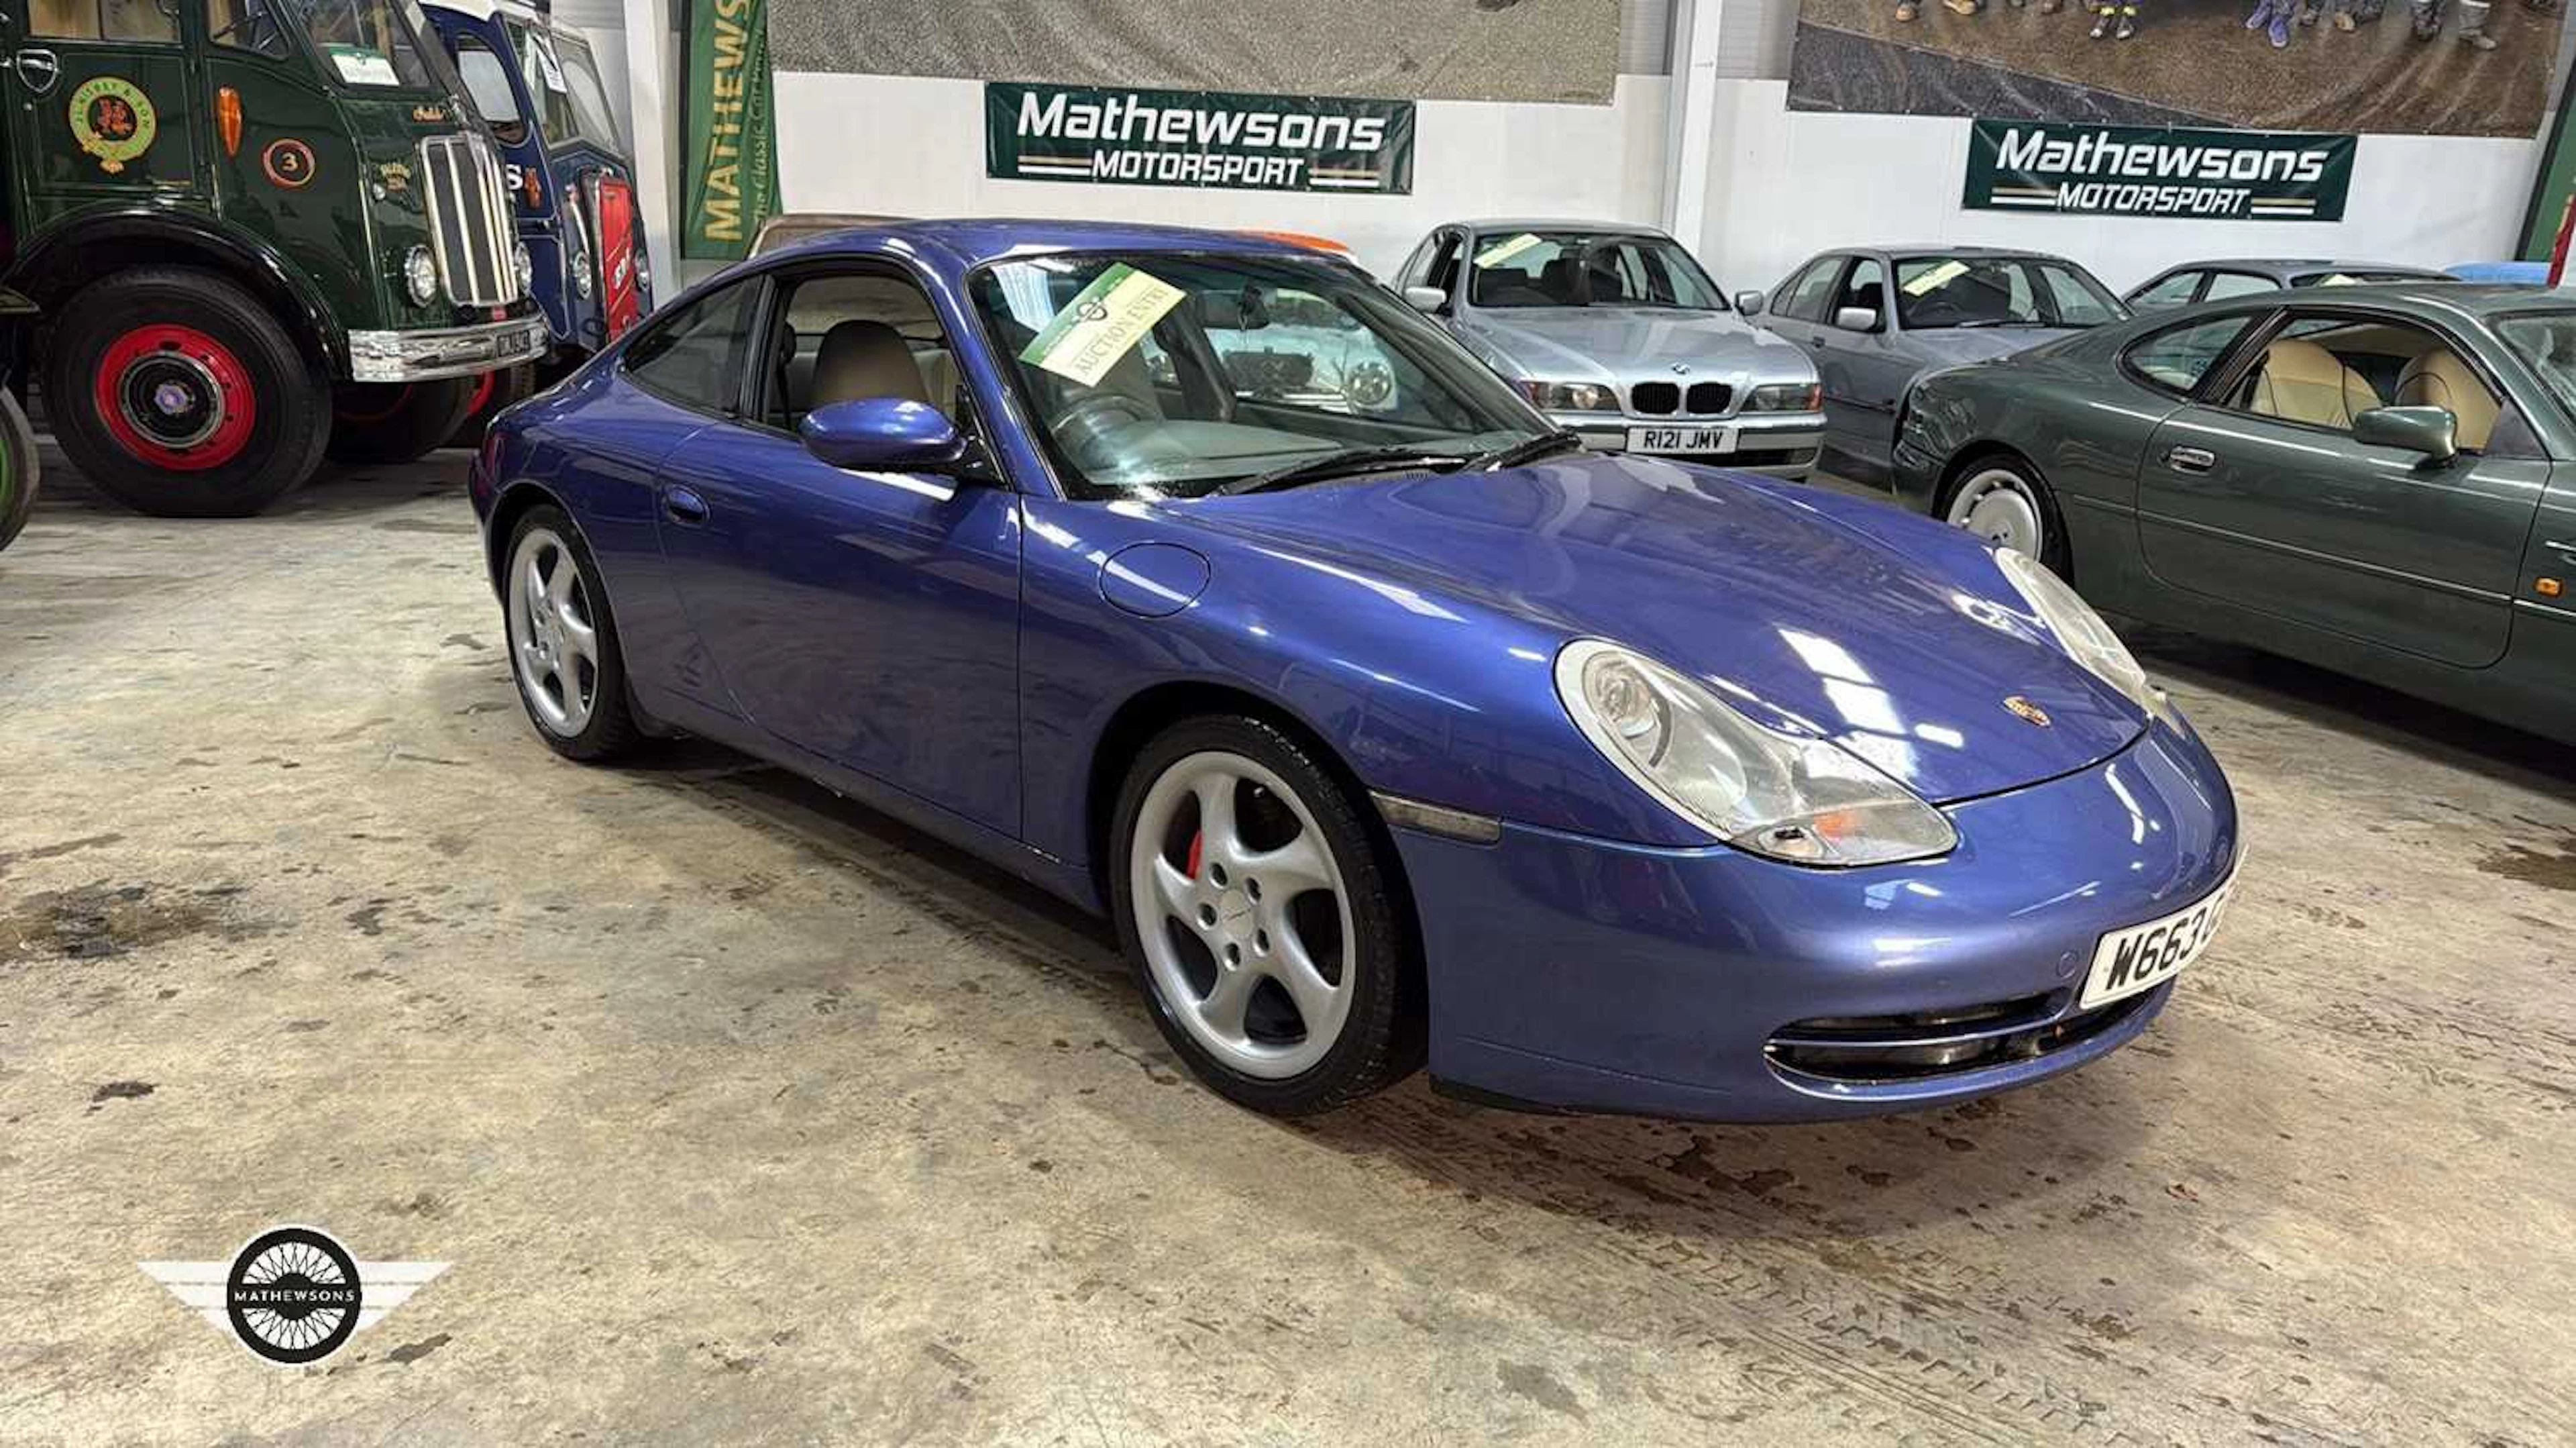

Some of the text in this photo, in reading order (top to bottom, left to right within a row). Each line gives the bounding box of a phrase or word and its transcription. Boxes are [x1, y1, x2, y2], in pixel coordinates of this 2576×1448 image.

[1018, 92, 1386, 151] Mathewsons
[282, 152, 297, 171] 3
[751, 125, 769, 190] Classic
[1092, 150, 1305, 185] MOTORSPORT
[1996, 128, 2328, 181] Mathewsons
[2057, 182, 2251, 214] MOTORSPORT
[1075, 317, 1134, 374] AUCTION
[1644, 430, 1723, 449] R121 JMV
